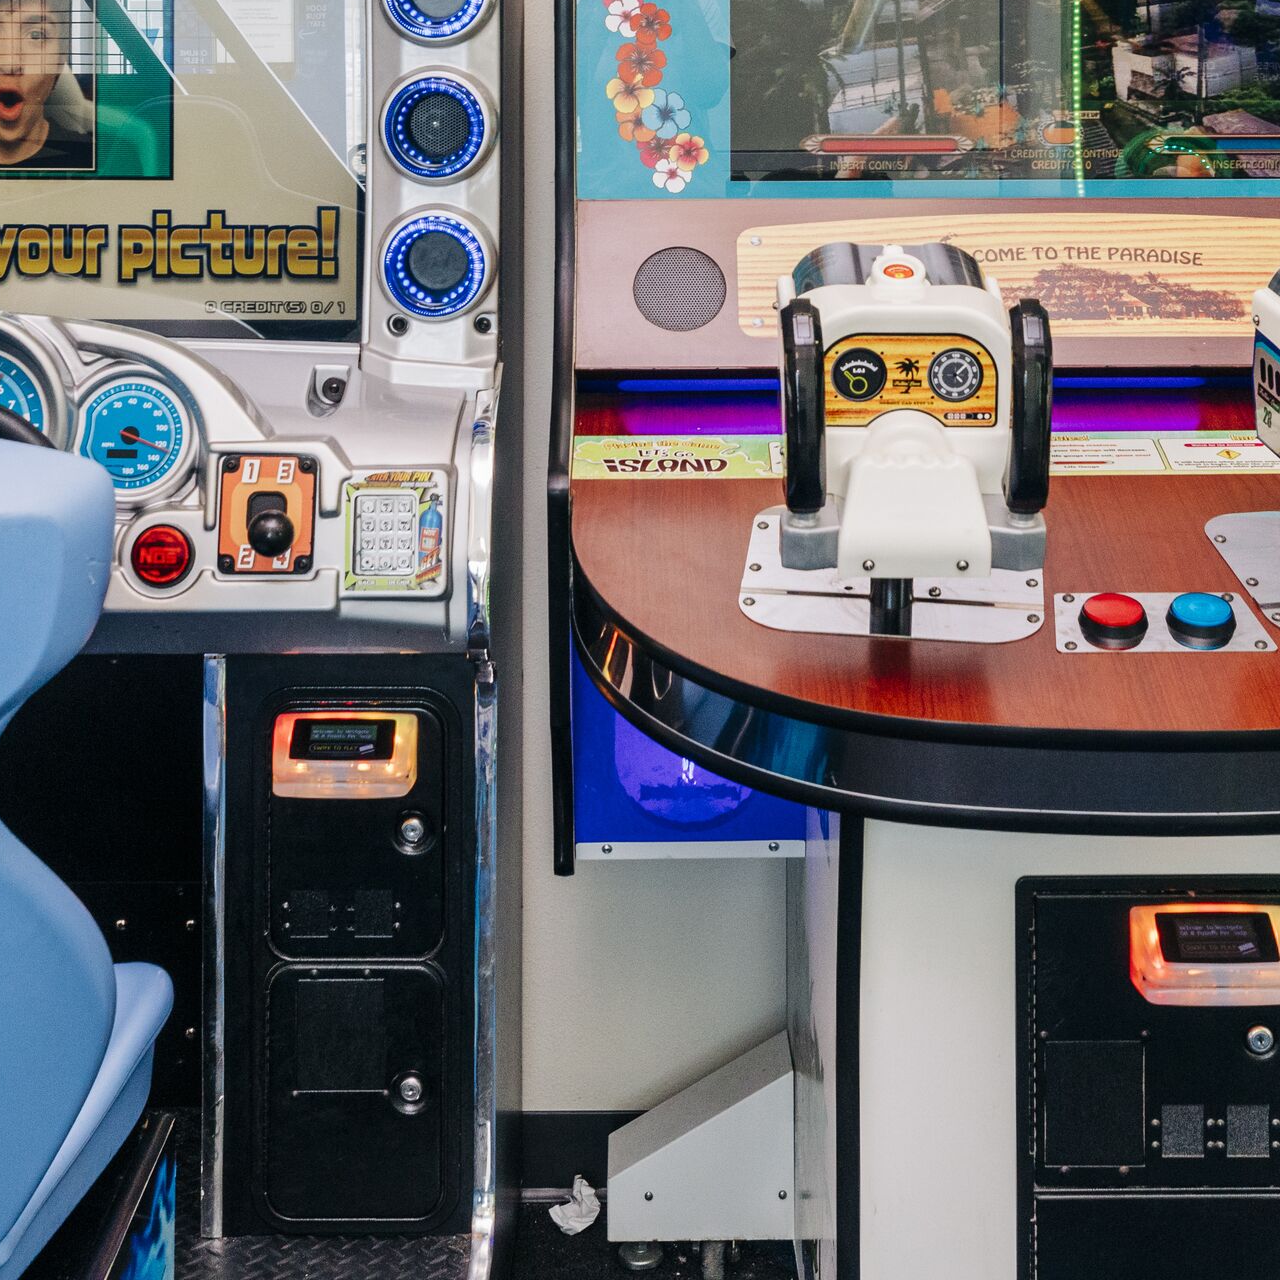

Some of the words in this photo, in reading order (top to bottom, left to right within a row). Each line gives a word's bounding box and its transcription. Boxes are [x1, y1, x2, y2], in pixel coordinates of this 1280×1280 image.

[1081, 149, 1125, 159] ONTINUE
[829, 160, 867, 171] INSERT
[1212, 159, 1251, 170] INSERT
[122, 206, 341, 283] picture!
[1031, 246, 1058, 261] TO
[1064, 246, 1101, 261] THE
[1107, 247, 1204, 267] PARADISE
[220, 300, 307, 315] CREDIT(S)
[138, 546, 182, 566] NOS
